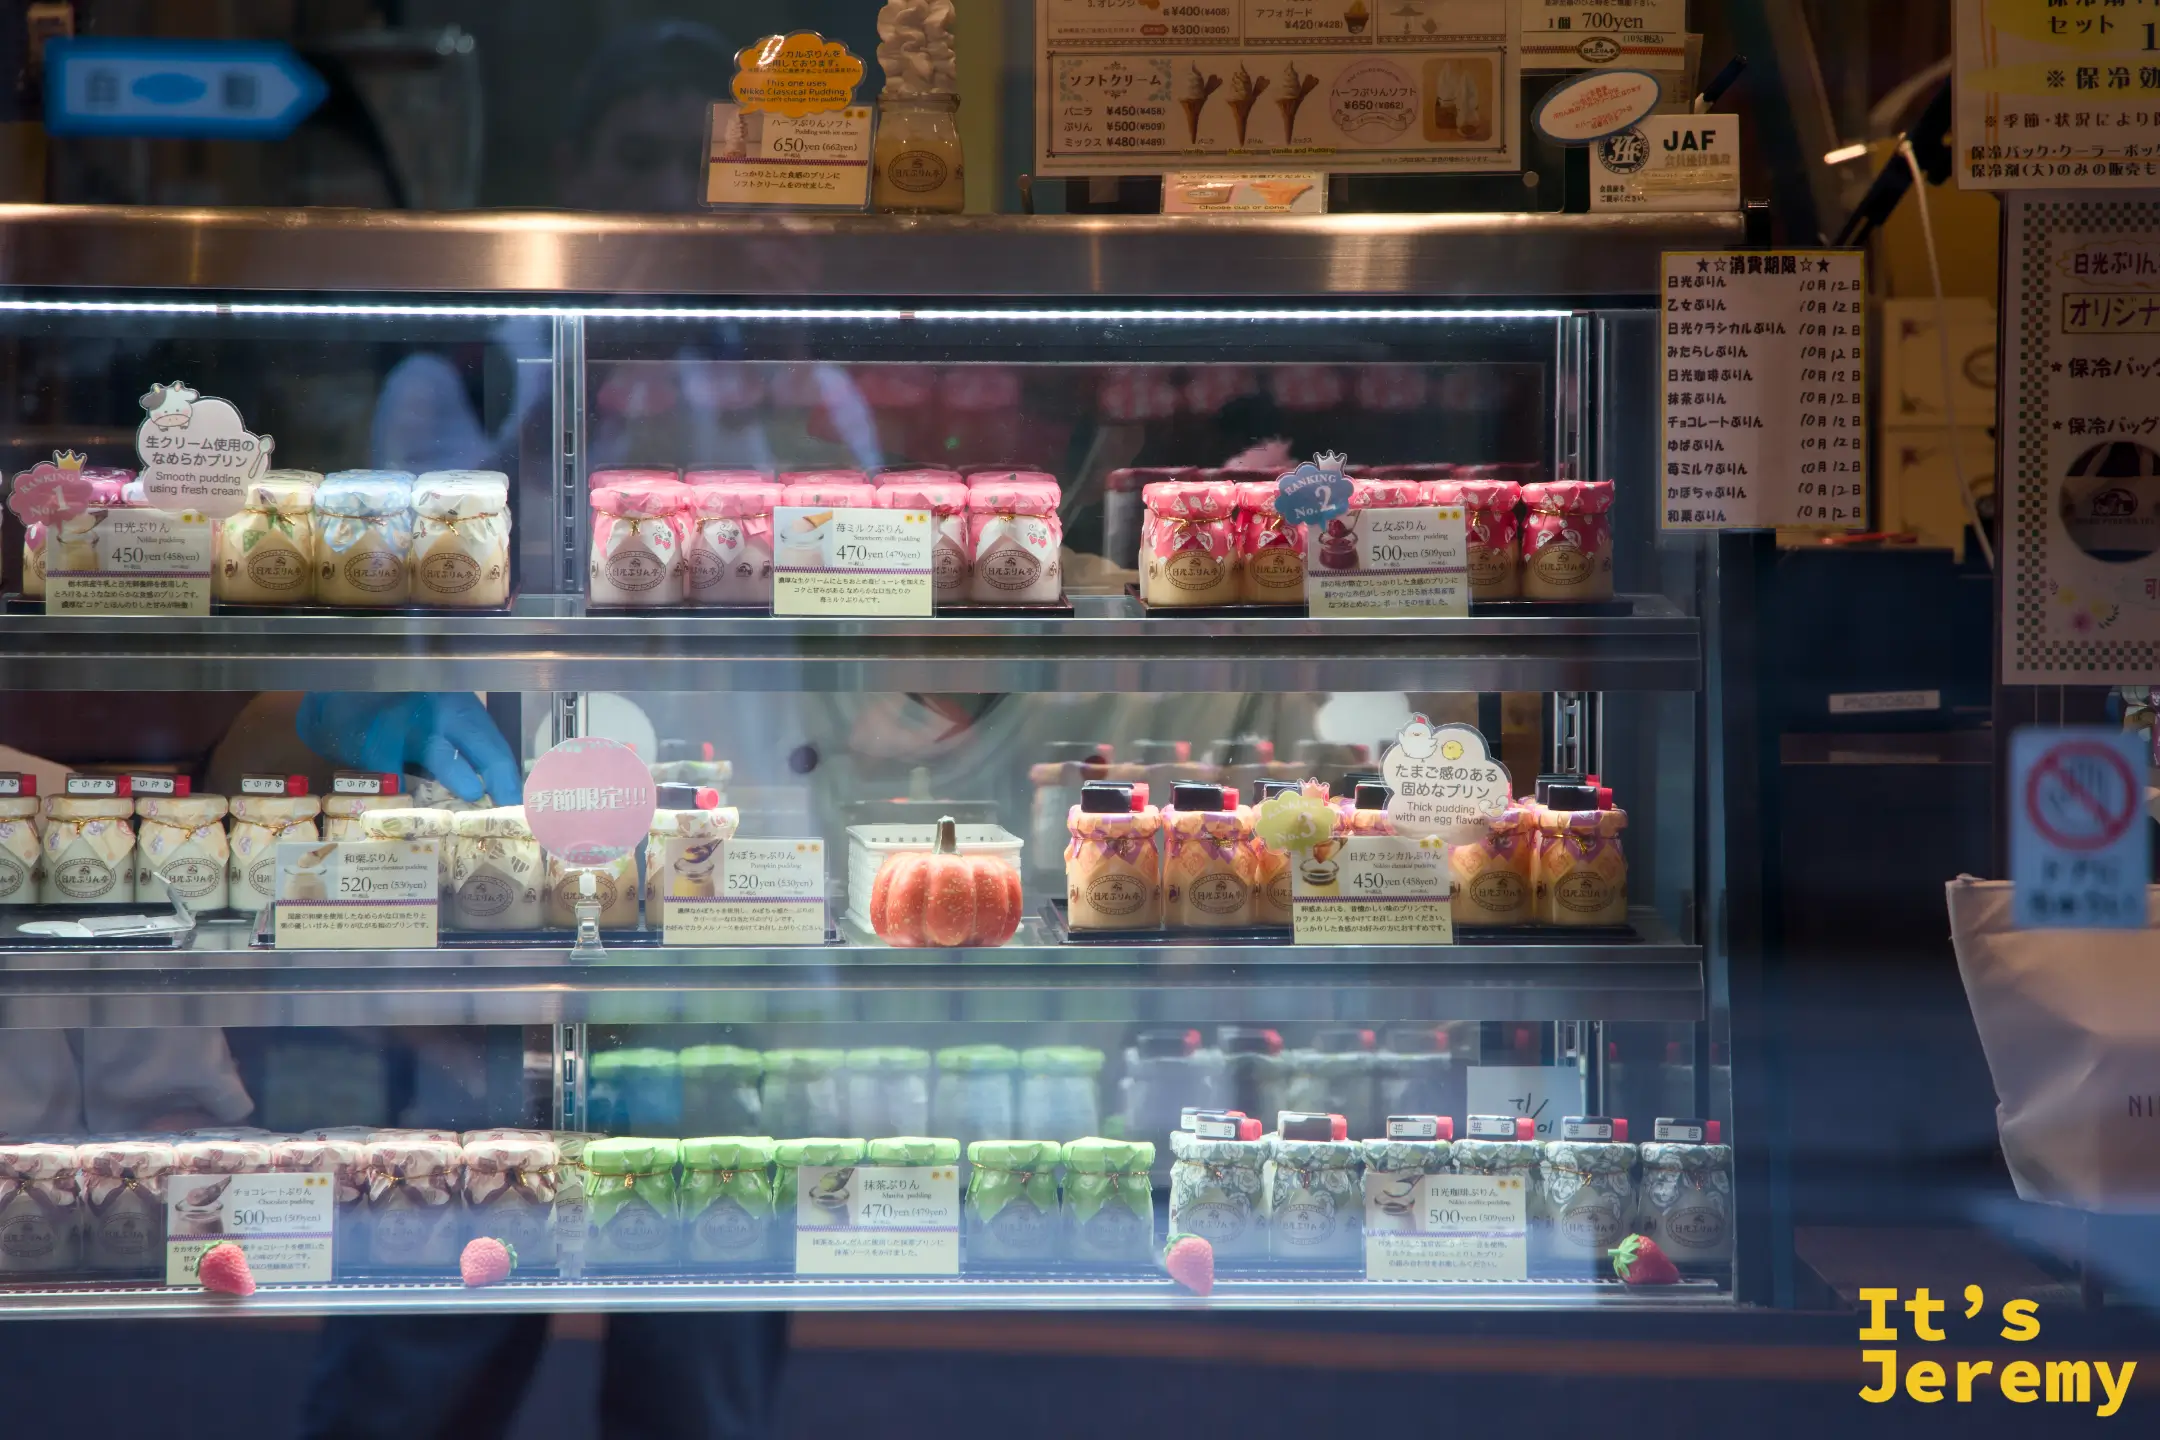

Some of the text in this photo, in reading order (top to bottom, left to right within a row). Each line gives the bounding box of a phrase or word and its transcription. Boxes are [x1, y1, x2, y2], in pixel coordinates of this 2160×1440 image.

[1582, 12, 1644, 31] 700yen
[2047, 15, 2115, 34] セット
[767, 60, 839, 68] 用しております。
[1070, 74, 1162, 87] ソフトクリーム
[767, 88, 807, 96] Classical
[1331, 88, 1417, 97] ハーフぷりんソフト
[1064, 106, 1093, 116] バニラ
[1064, 122, 1093, 132] ぷりん
[773, 137, 858, 152] 650yen (662yen)
[1064, 138, 1102, 147] ミックス
[1663, 130, 1717, 151] JAF
[2074, 252, 2160, 275] 日光ぷりん
[1668, 276, 1727, 288] 日光ぷりん
[1668, 299, 1727, 311] 乙女ぷりん
[1668, 322, 1786, 335] 日光クラシカルぷりん
[1667, 346, 1749, 359] みたらしぷりん
[1668, 369, 1753, 382] 日光珈琲ぷりん
[1668, 392, 1727, 405] 抹茶ぷりん
[1668, 416, 1763, 428] チョコレートぷりん
[145, 436, 255, 452] 生クリーム使用の
[1668, 439, 1725, 452] ゆばぷりん
[151, 454, 248, 468] なめらかプリン
[1668, 462, 1748, 475] 苺ミルクぷりん
[19, 472, 75, 494] RANKING
[156, 472, 241, 485] Smooth pudding
[1284, 473, 1337, 496] RANKING
[150, 484, 246, 497] using fresh cream.
[1668, 486, 1748, 499] かぼちゃぷりん
[1668, 509, 1727, 522] 和栗ぷりん
[114, 522, 170, 534] 日光ぷりん
[836, 523, 904, 534] 苺ミルクぷりん
[1371, 521, 1427, 532] 乙女ぷりん
[111, 547, 200, 563] 450yen (458yen)
[836, 545, 884, 561] 470yen
[1371, 545, 1419, 562] 500yen
[1396, 765, 1498, 782] たまご感のある
[1401, 783, 1490, 799] 固めなプリン
[1407, 801, 1475, 816] Thick pudding
[1395, 813, 1417, 823] with
[1418, 815, 1432, 823] an
[1434, 815, 1451, 826] egg
[344, 853, 398, 864] 和栗ぷりん
[728, 851, 796, 861] かぼちゃぷりん
[1349, 851, 1442, 862] 日光クラシカルぷりん
[340, 877, 389, 893] 520yen
[728, 875, 776, 890] 520yen
[1353, 873, 1438, 889] 450yen (458yen)
[2129, 1095, 2160, 1119] NI
[864, 1179, 920, 1191] 抹茶ぷりん
[233, 1188, 312, 1196] チョコレートぷりん
[1431, 1188, 1498, 1197] 日光珈琲ぷりん
[861, 1203, 910, 1218] 470yen
[1429, 1209, 1479, 1224] 500yen
